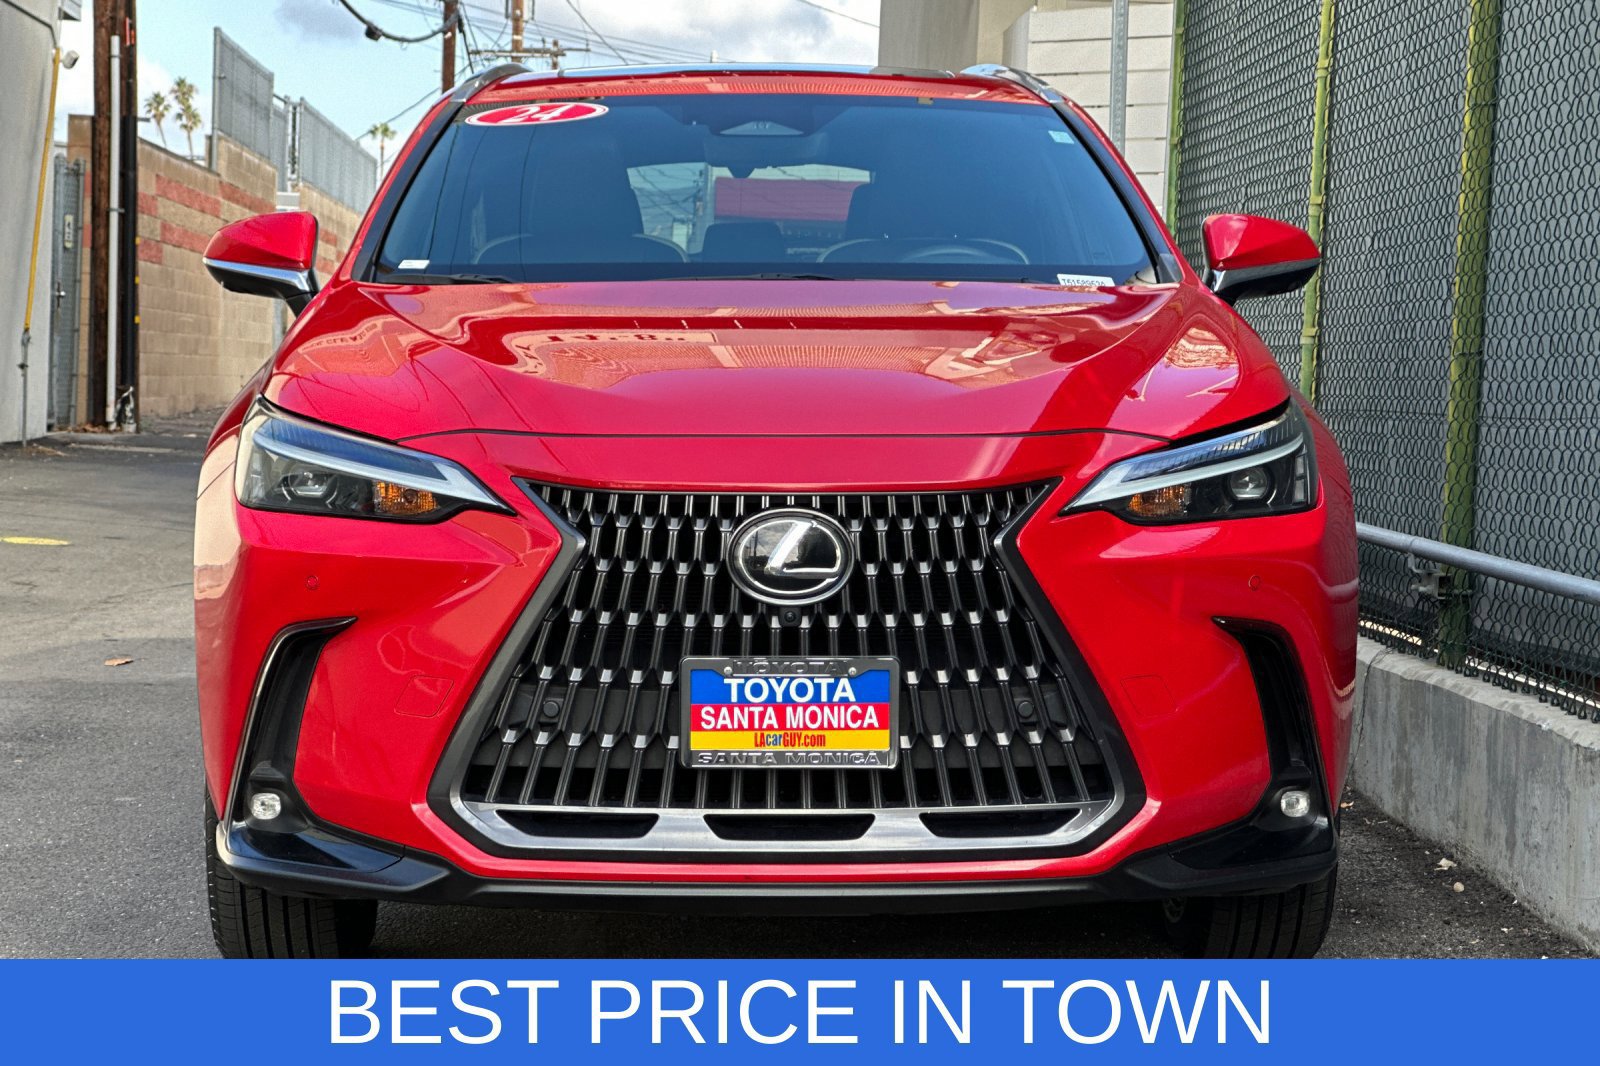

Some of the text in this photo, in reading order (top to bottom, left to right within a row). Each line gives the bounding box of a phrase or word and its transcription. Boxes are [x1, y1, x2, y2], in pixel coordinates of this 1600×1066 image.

[497, 103, 575, 123] 24
[735, 661, 847, 674] TOYOTA
[724, 677, 856, 703] TOYOTA
[701, 704, 879, 730] SANTA MONICA
[754, 732, 826, 748] LAcarGUY.com
[698, 752, 881, 766] SANTA MONICA
